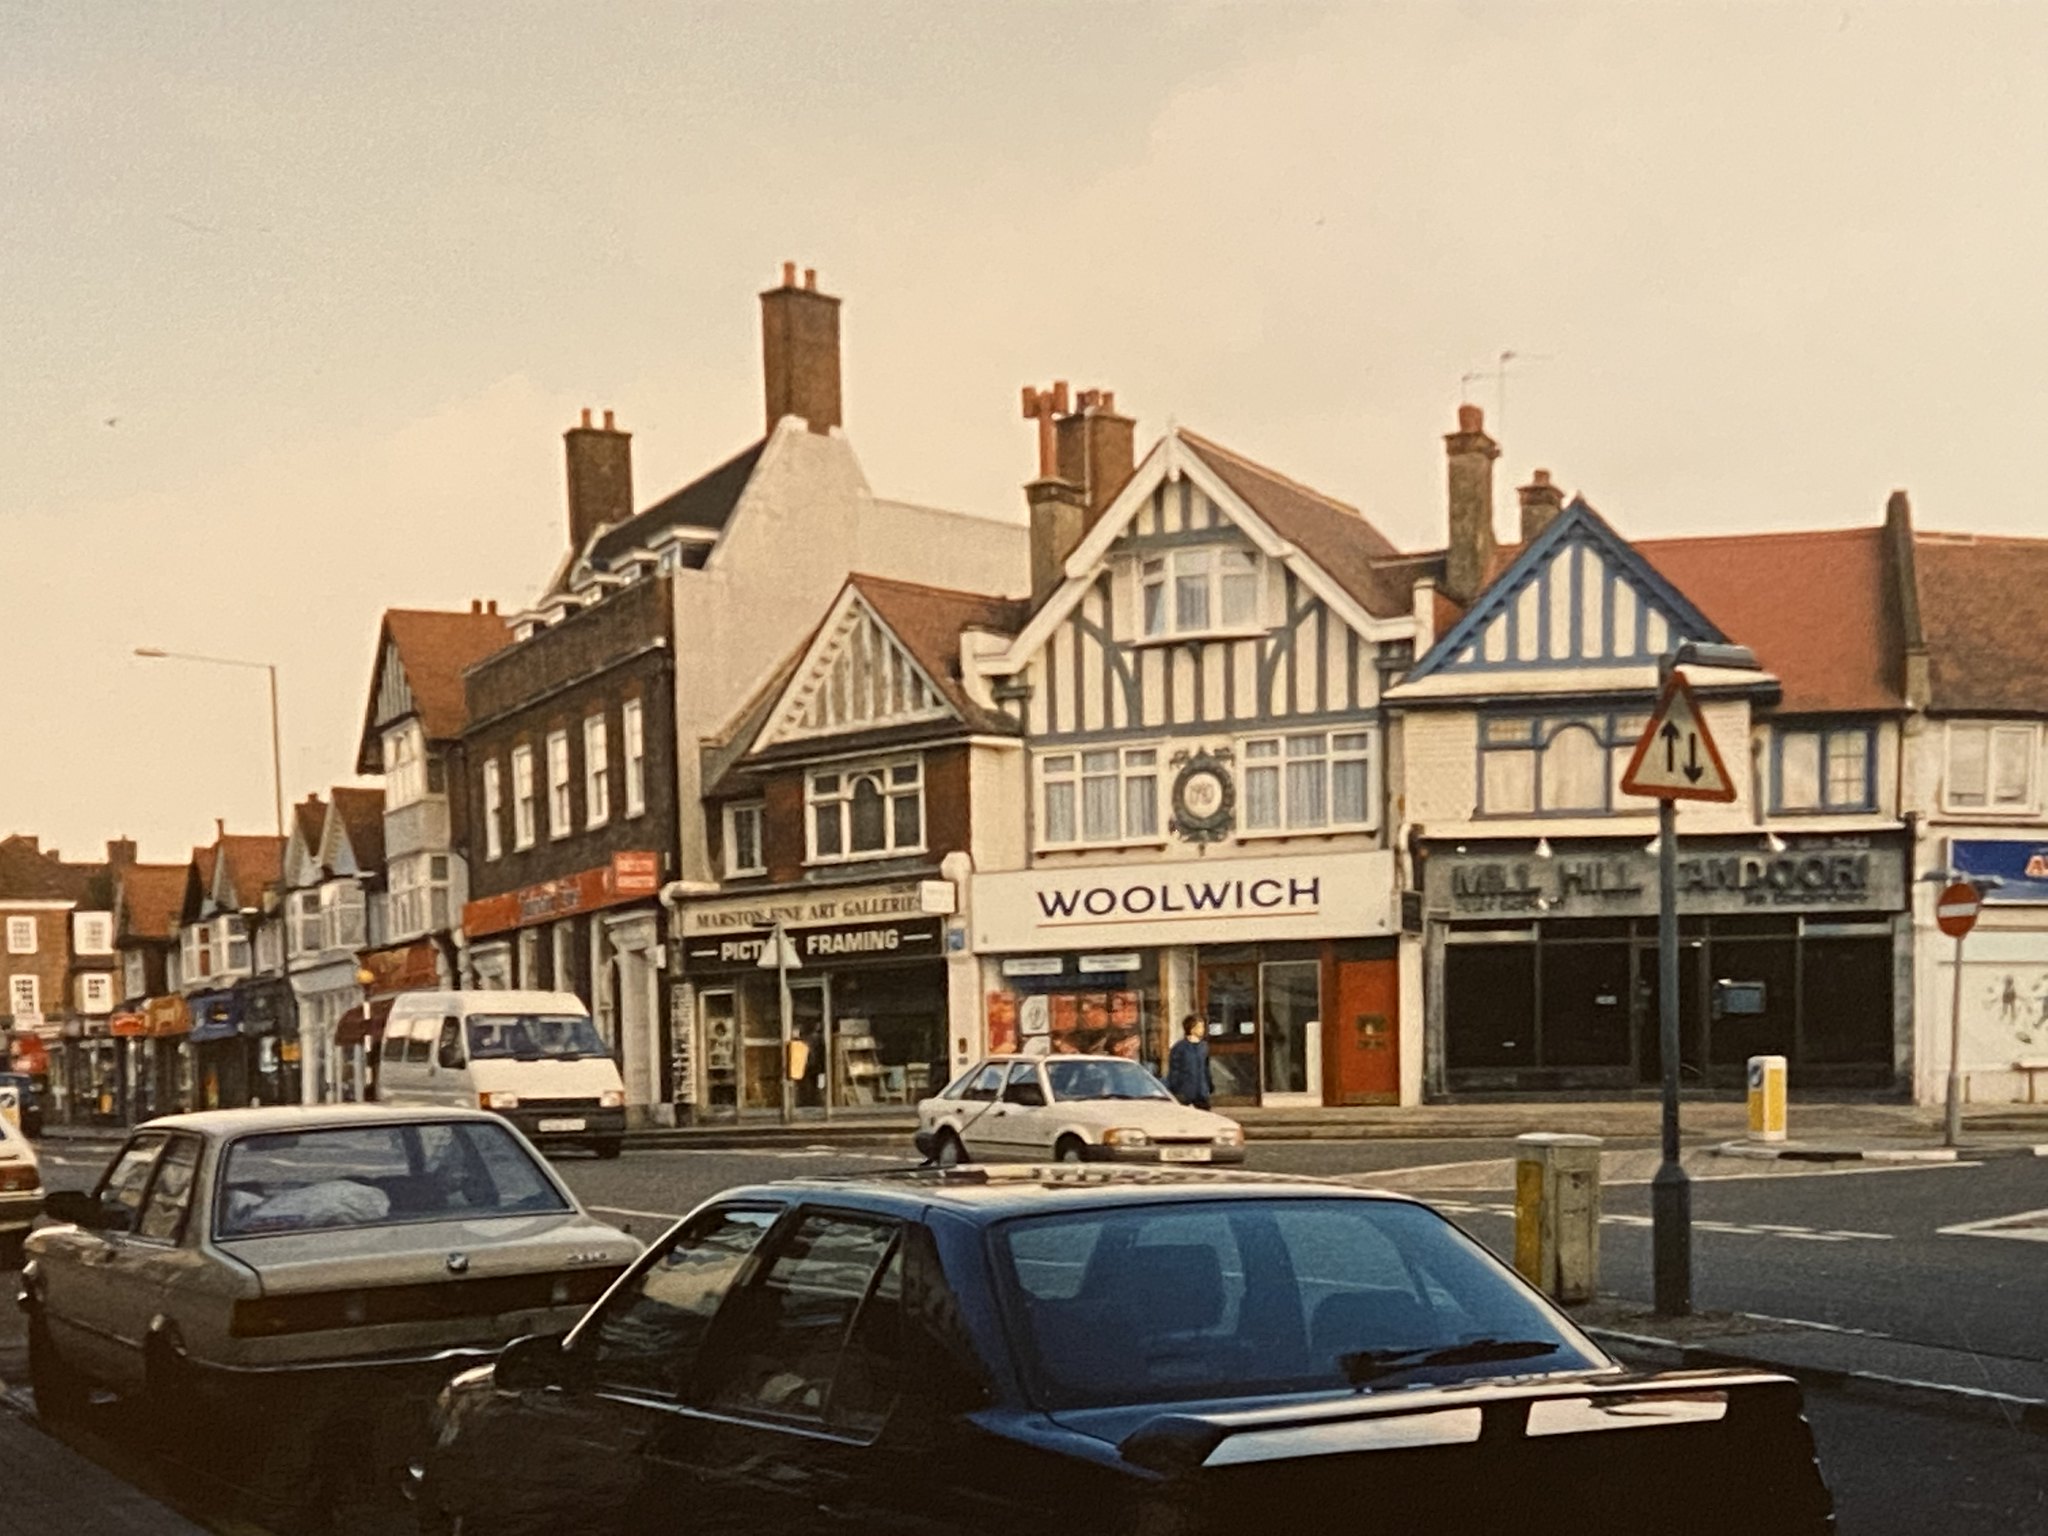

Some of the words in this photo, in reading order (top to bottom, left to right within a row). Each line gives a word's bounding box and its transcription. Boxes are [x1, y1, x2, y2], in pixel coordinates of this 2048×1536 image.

[1452, 863, 1542, 898] MILL
[1558, 862, 1645, 896] HILL
[1674, 855, 1870, 891] ANDOORI
[808, 902, 837, 919] ART
[1036, 877, 1320, 917] WOOLWICH
[806, 928, 899, 955] FRAMING
